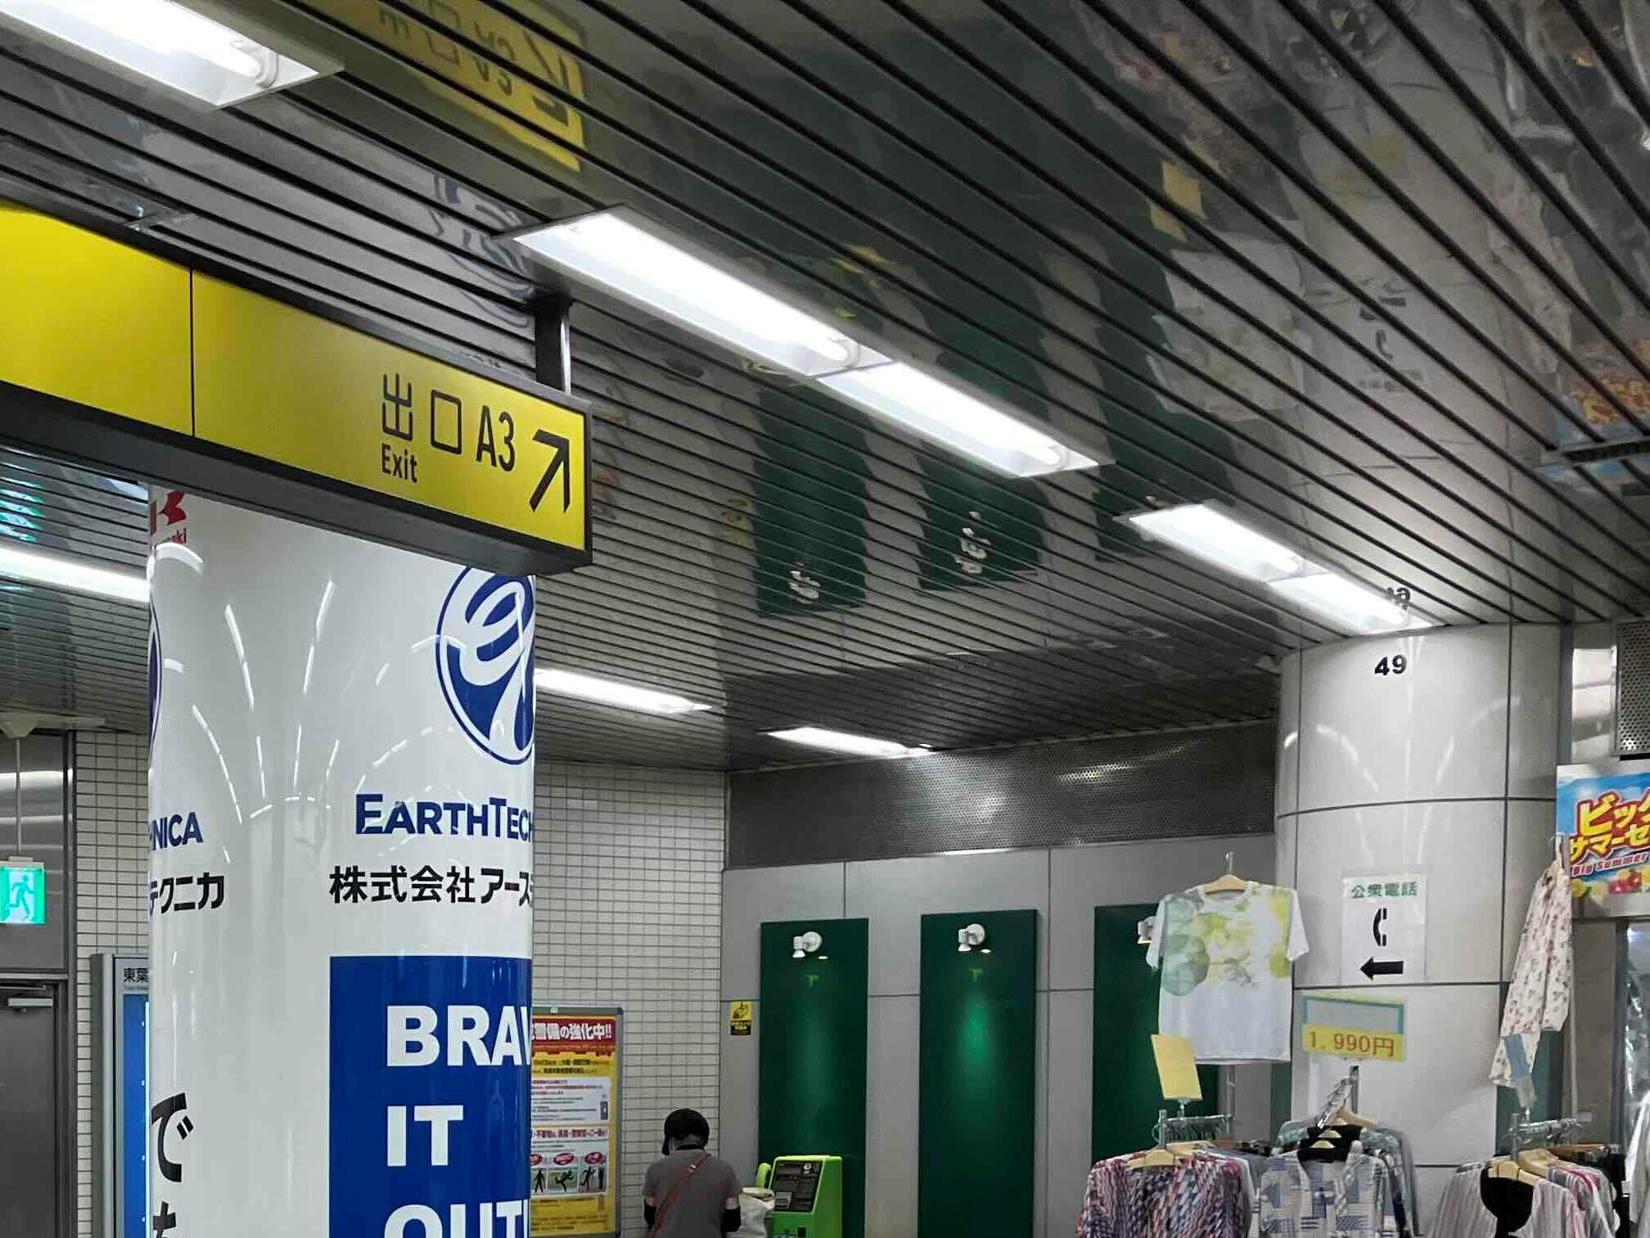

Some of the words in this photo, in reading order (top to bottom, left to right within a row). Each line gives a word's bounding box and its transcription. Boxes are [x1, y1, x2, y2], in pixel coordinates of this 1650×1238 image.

[382, 373, 462, 455] 出口
[476, 405, 516, 472] A3
[381, 443, 418, 483] Exit
[1374, 655, 1407, 676] 49
[329, 866, 533, 906] 株式会社アース
[1351, 881, 1418, 899] 公衆電話
[387, 1105, 463, 1167] IT
